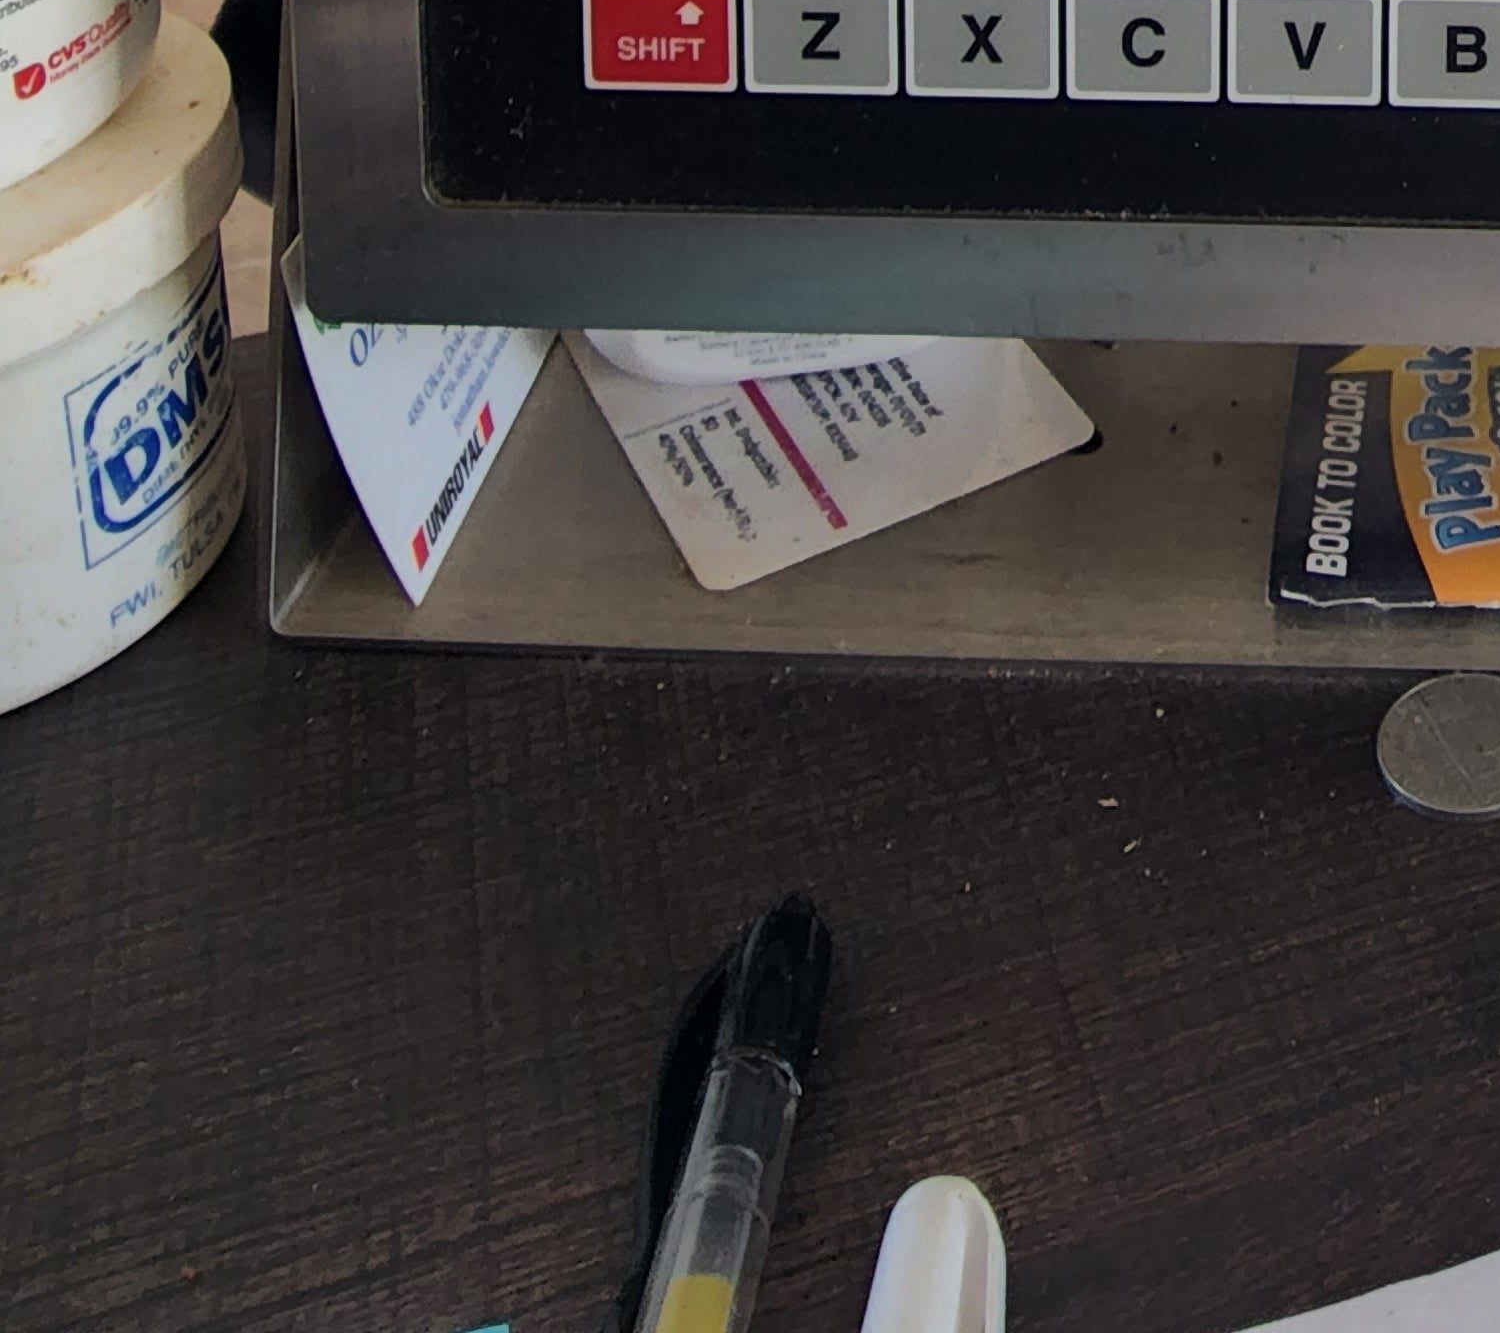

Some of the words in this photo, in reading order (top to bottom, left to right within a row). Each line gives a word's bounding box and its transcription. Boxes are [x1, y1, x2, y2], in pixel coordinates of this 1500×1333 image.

[617, 36, 705, 63] SHIFT
[802, 12, 840, 60] Z
[962, 15, 1002, 63] X
[1122, 18, 1165, 67] C
[1284, 22, 1326, 70] V
[1446, 26, 1487, 73] B
[1322, 379, 1367, 454] COLOR
[1403, 345, 1478, 444] Pack
[425, 425, 486, 547] UNIROYAL
[1317, 458, 1358, 489] TO
[1306, 494, 1355, 578] BOOK
